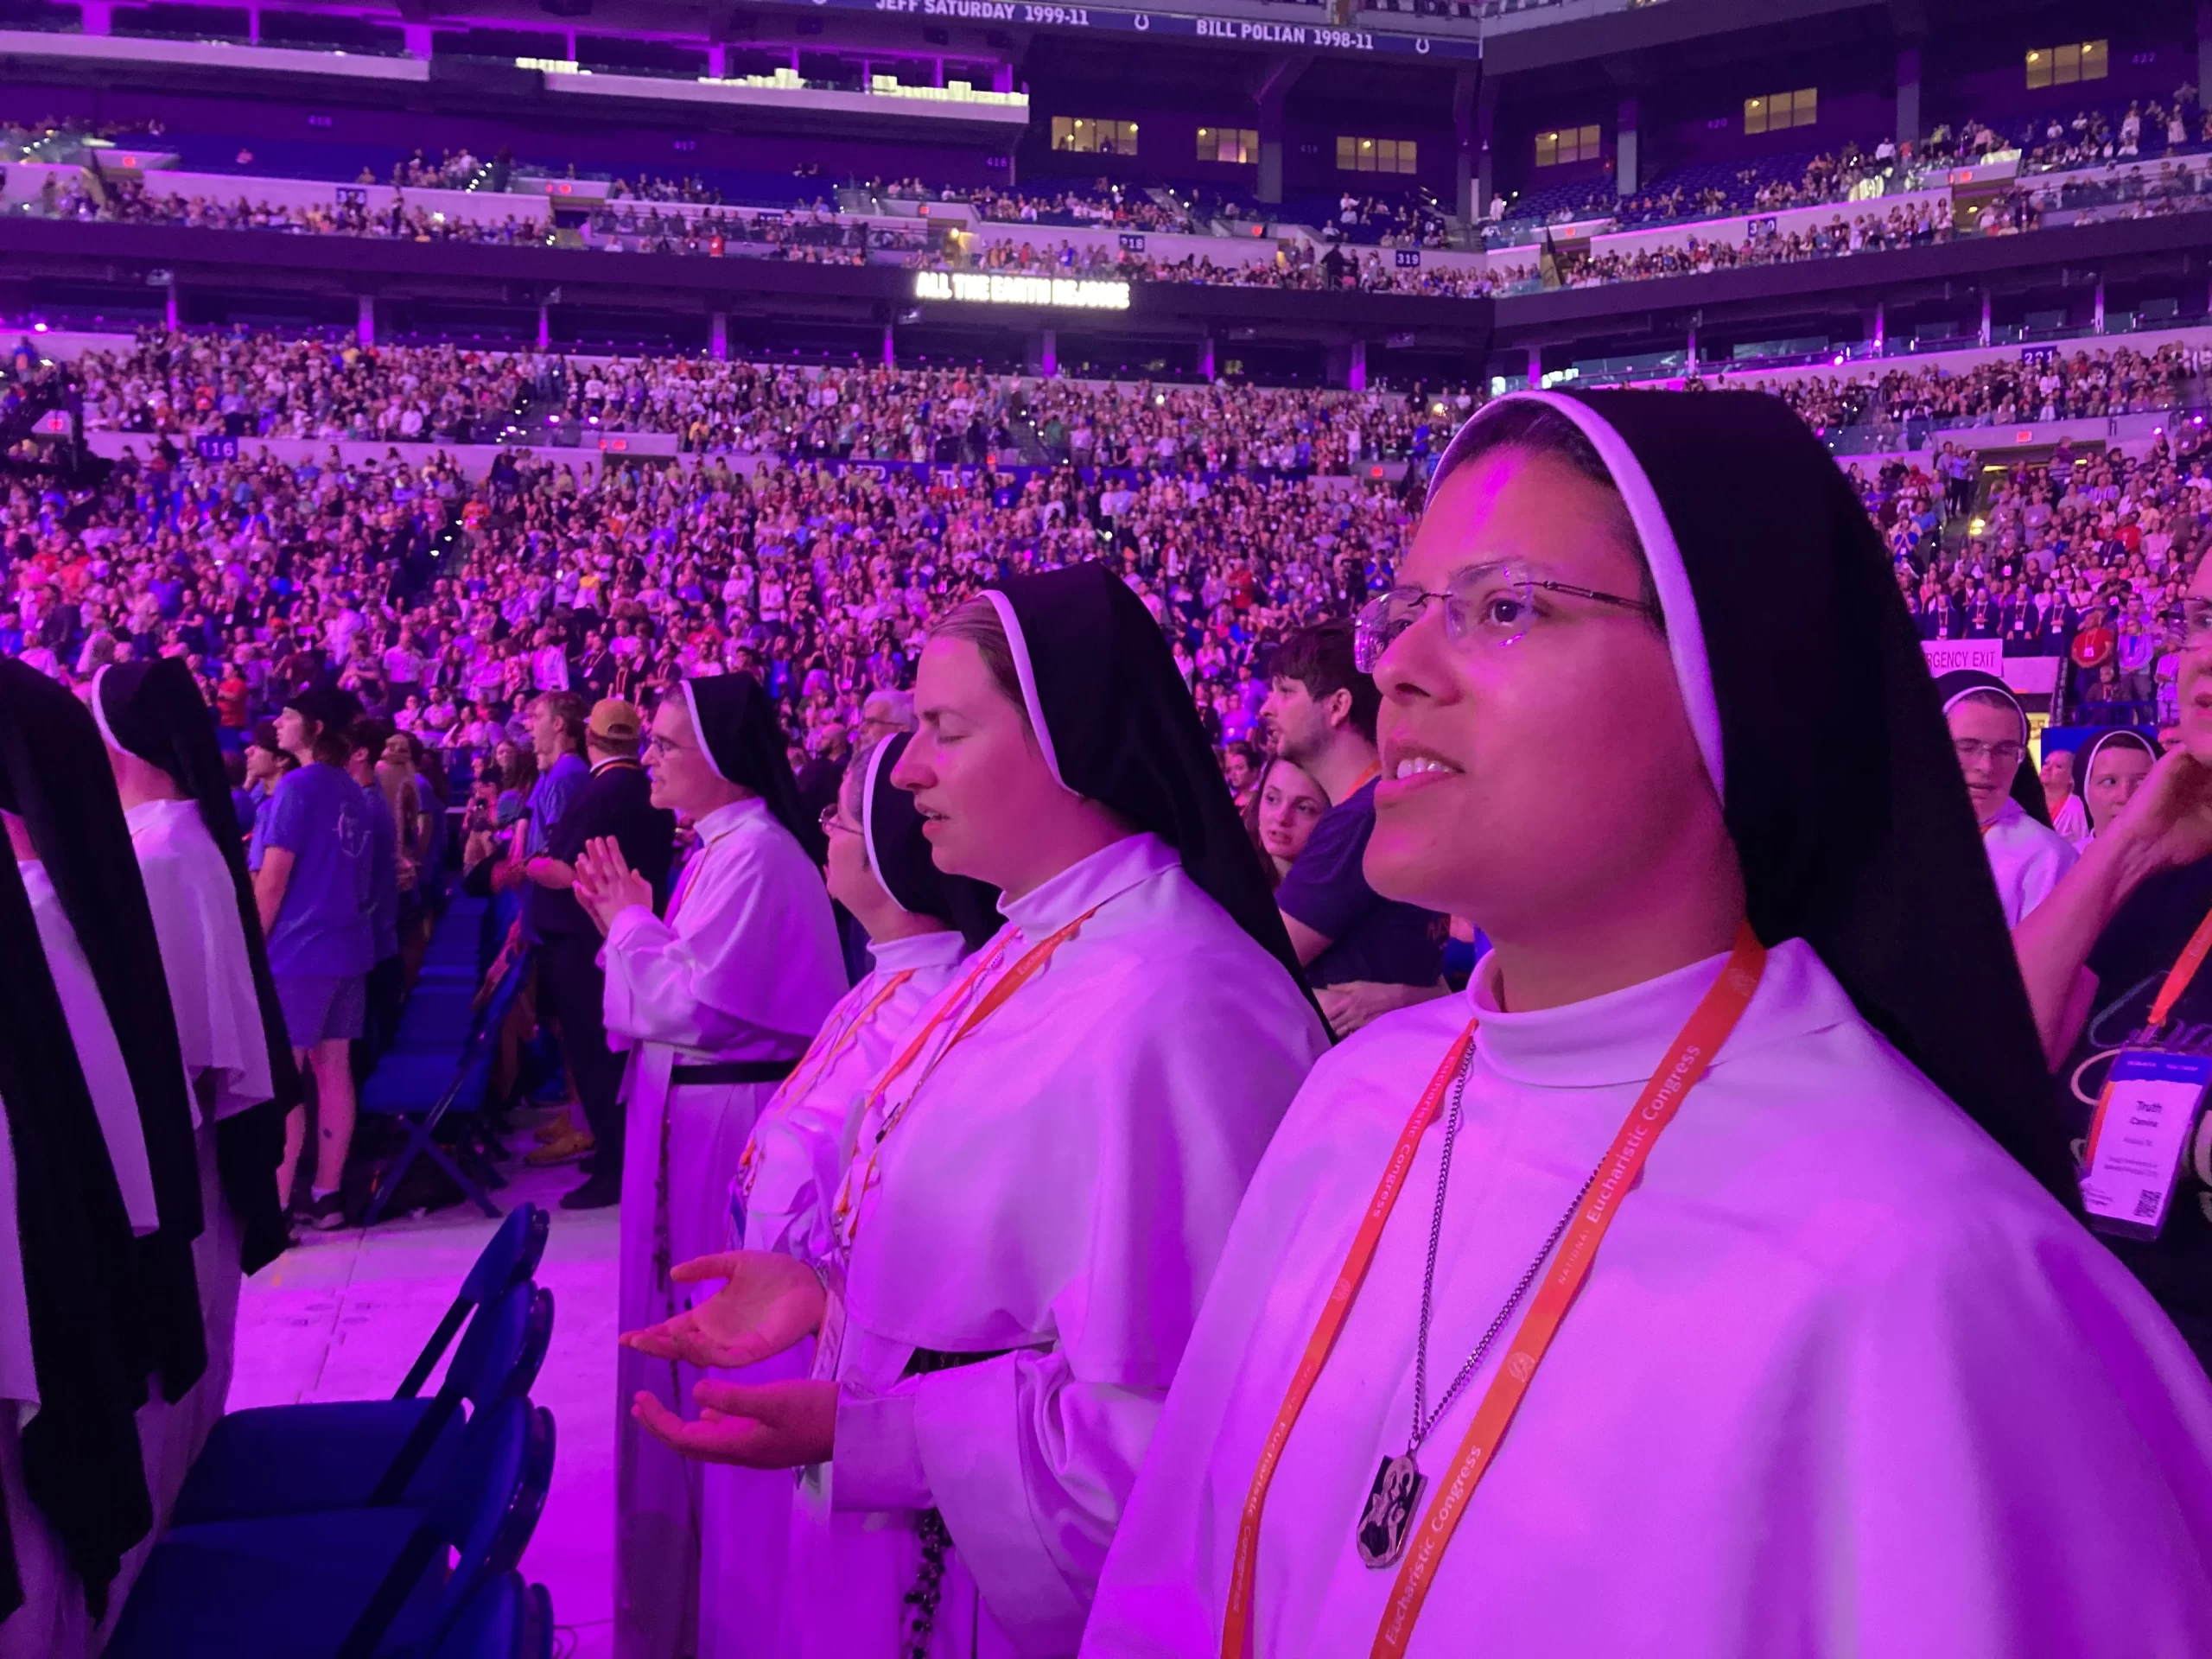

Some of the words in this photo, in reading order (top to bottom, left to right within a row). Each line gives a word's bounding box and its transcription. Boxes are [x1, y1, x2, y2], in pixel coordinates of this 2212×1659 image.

[875, 0, 918, 12] JEFF
[924, 0, 1015, 20] SATURDAY
[1024, 5, 1089, 25] 1999-11
[1196, 19, 1237, 38] BILL
[1241, 24, 1306, 43] POLIAN
[1313, 29, 1374, 50] 1998-11
[1750, 219, 1775, 234] 30
[1397, 253, 1419, 264] 319
[916, 271, 953, 300] ALL
[200, 442, 234, 456] 116
[1973, 652, 1995, 667] EXIT
[1586, 1124, 1649, 1224] Eucharistic
[1642, 1045, 1700, 1121] Congress
[1372, 1143, 1411, 1218] Congress
[1384, 1535, 1435, 1646] Eucharistic
[1432, 1444, 1481, 1533] Congress
